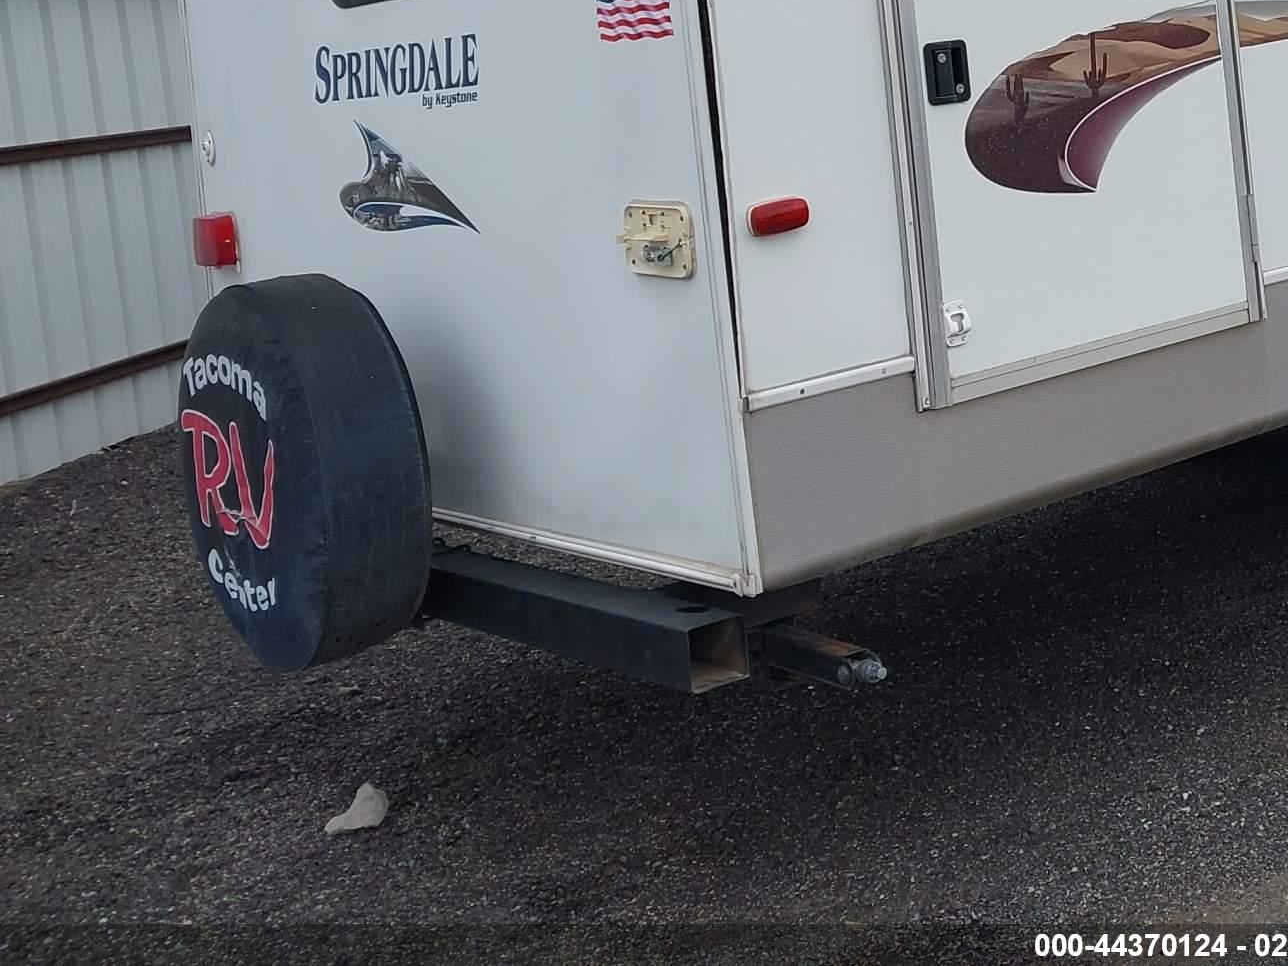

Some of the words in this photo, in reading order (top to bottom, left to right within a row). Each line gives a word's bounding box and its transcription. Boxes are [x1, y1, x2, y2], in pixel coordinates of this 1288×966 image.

[315, 34, 479, 104] SPRINGDALE
[421, 94, 433, 109] by
[435, 91, 478, 107] Keystone
[183, 353, 267, 421] Tacoma
[181, 409, 275, 549] RV
